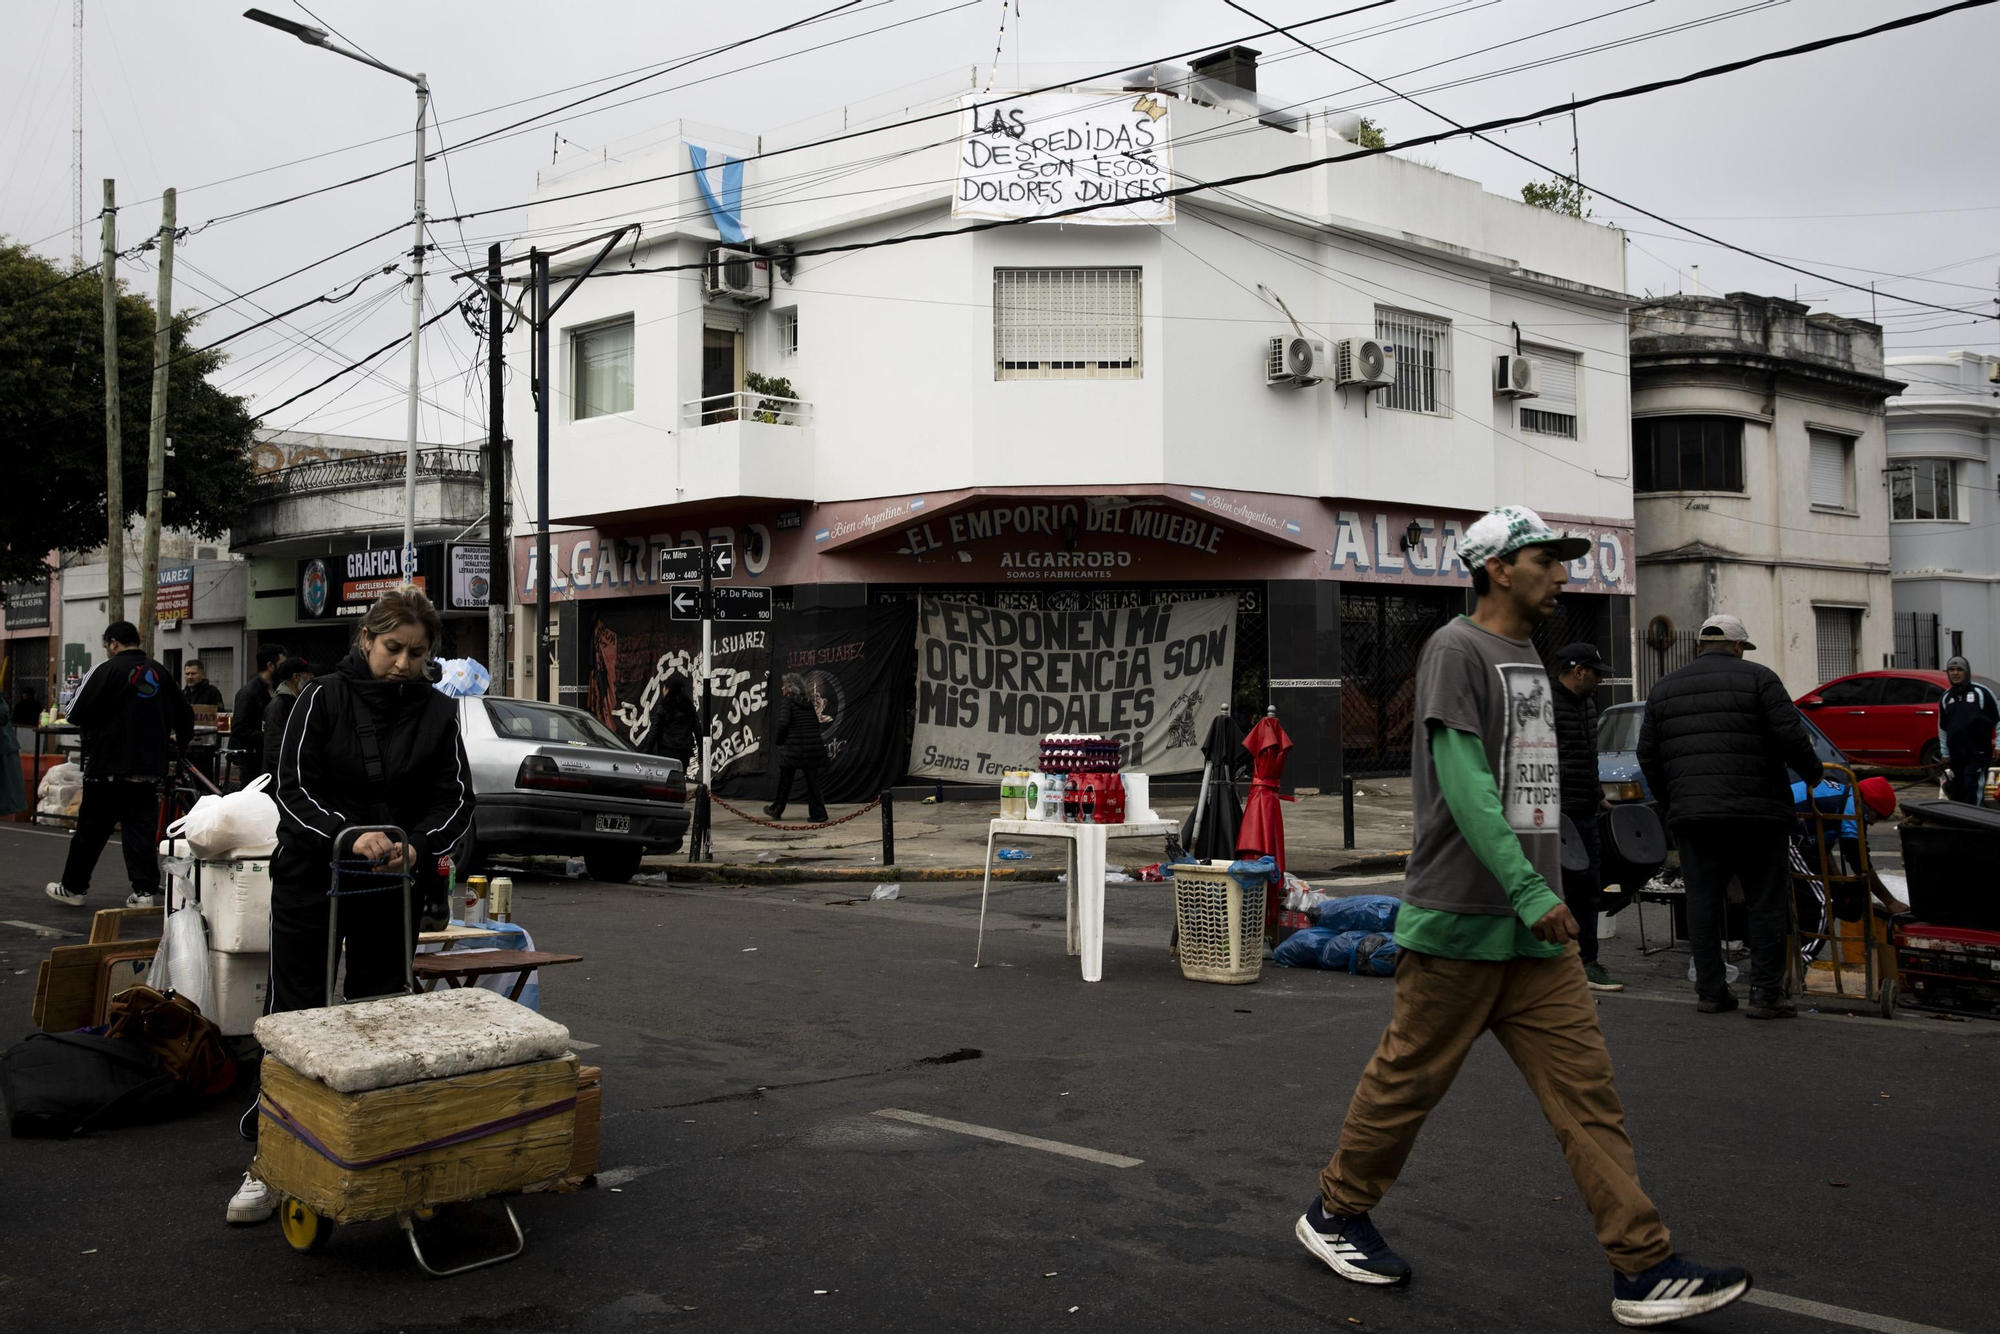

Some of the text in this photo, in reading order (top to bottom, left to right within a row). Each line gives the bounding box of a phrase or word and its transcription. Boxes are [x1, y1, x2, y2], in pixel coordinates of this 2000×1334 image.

[972, 103, 1026, 139] LAS
[1017, 155, 1159, 180] SON ESOS
[959, 177, 1166, 204] DOLORES DULCES
[1207, 495, 1233, 514] Bien
[830, 521, 856, 540] Bien
[906, 503, 1226, 555] EL EMPORIO DEL MUEBLE
[662, 551, 688, 560] Av. Mitre
[1332, 511, 1626, 584] ALGABO
[347, 549, 398, 579] GRAFICA
[1000, 551, 1132, 568] ALGARROBO
[157, 570, 189, 584] LVAREZ
[662, 572, 676, 580] 4500
[683, 570, 698, 579] 4400
[1006, 570, 1112, 579] SOMOS FABRICANTES
[720, 590, 764, 599] P. De Palos
[156, 609, 189, 622] ENDE
[720, 610, 726, 618] 0
[757, 610, 770, 619] 100
[921, 600, 1118, 650] PERDONEN
[1163, 624, 1228, 680] SON
[988, 687, 1155, 736] MODALES
[922, 745, 970, 772] Santa
[597, 817, 629, 830] BLY 733
